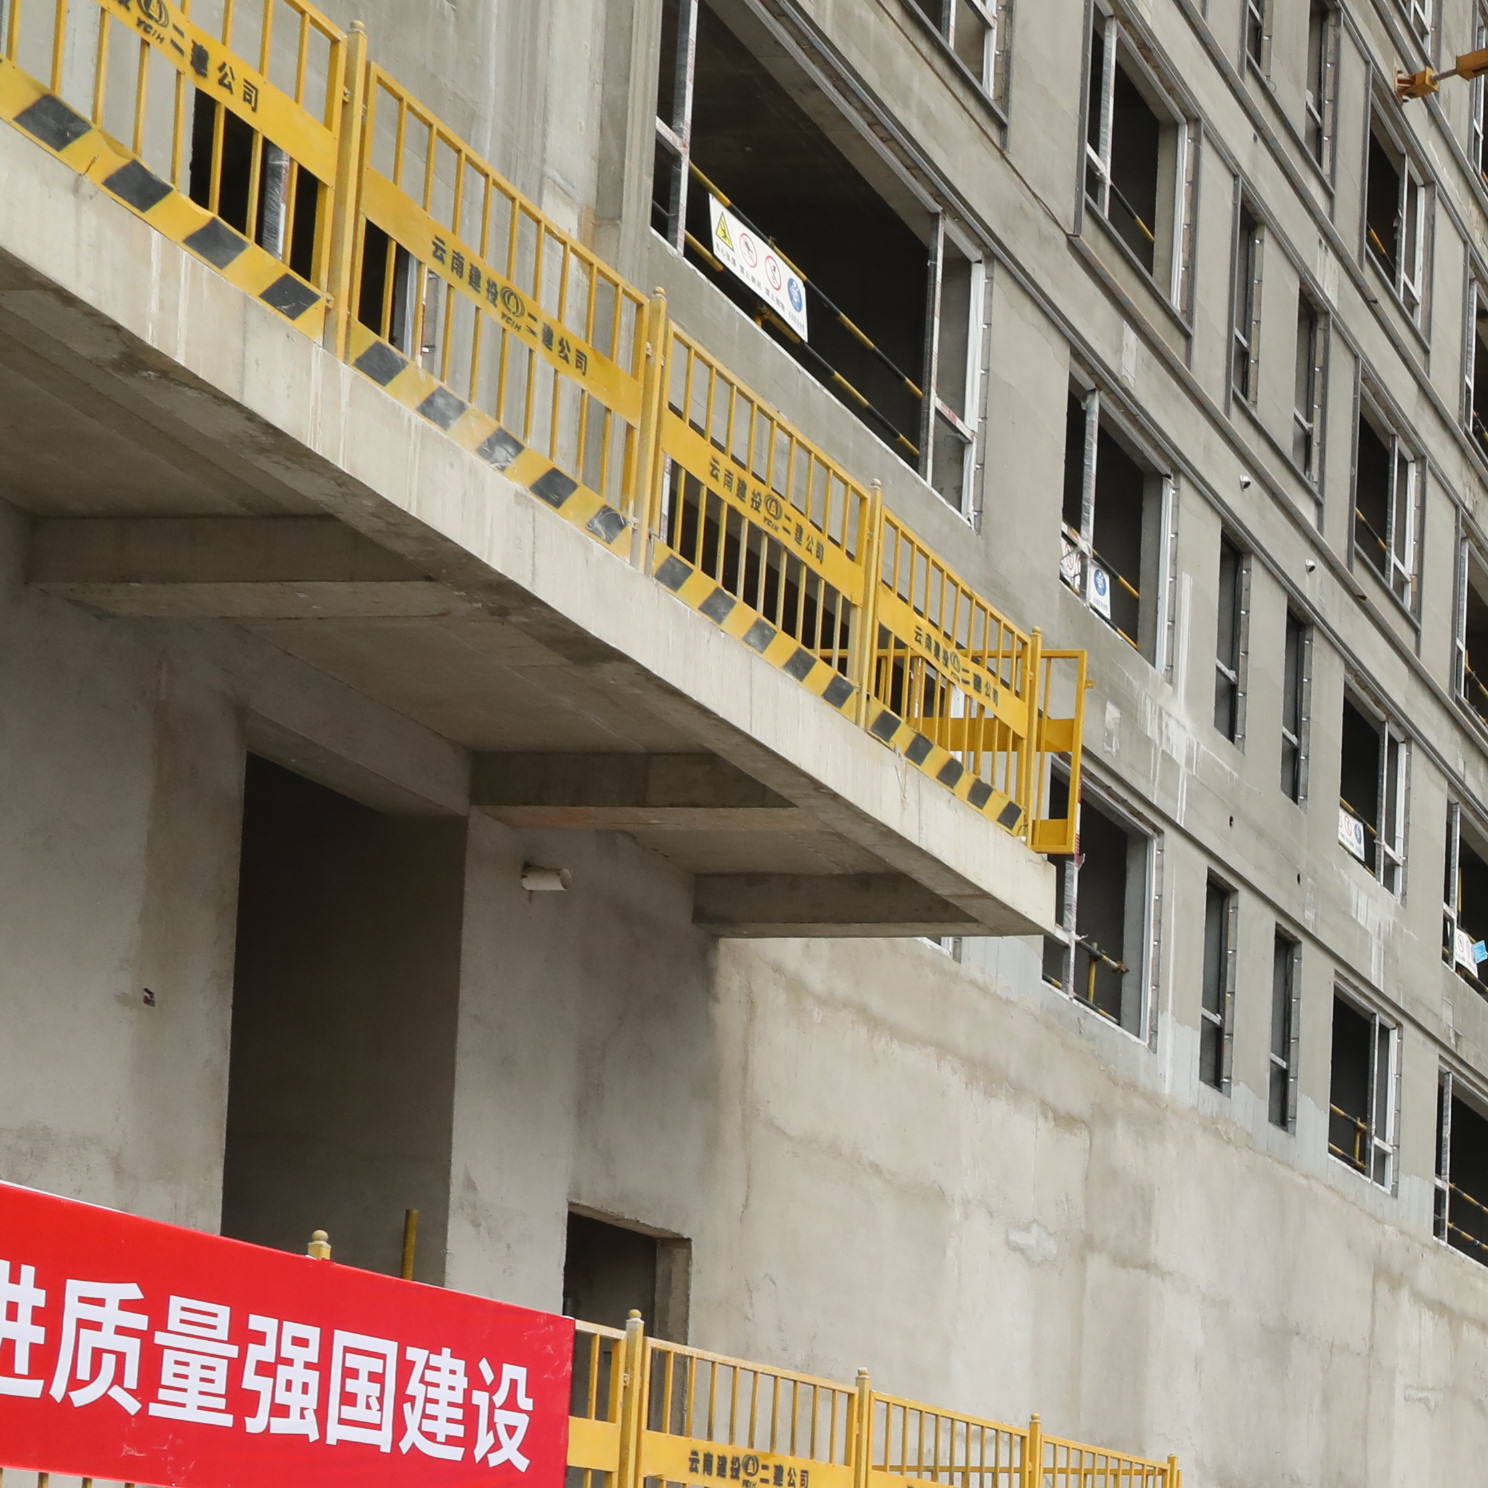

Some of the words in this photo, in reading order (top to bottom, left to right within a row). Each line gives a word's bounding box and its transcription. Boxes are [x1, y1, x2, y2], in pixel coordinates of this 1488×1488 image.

[170, 25, 260, 114] 二建公司
[431, 234, 501, 303] 云南建投
[527, 314, 589, 378] 二建公司
[708, 455, 762, 515] 云南建投
[784, 514, 825, 565] 二建公司
[688, 1450, 741, 1481] 云南建投
